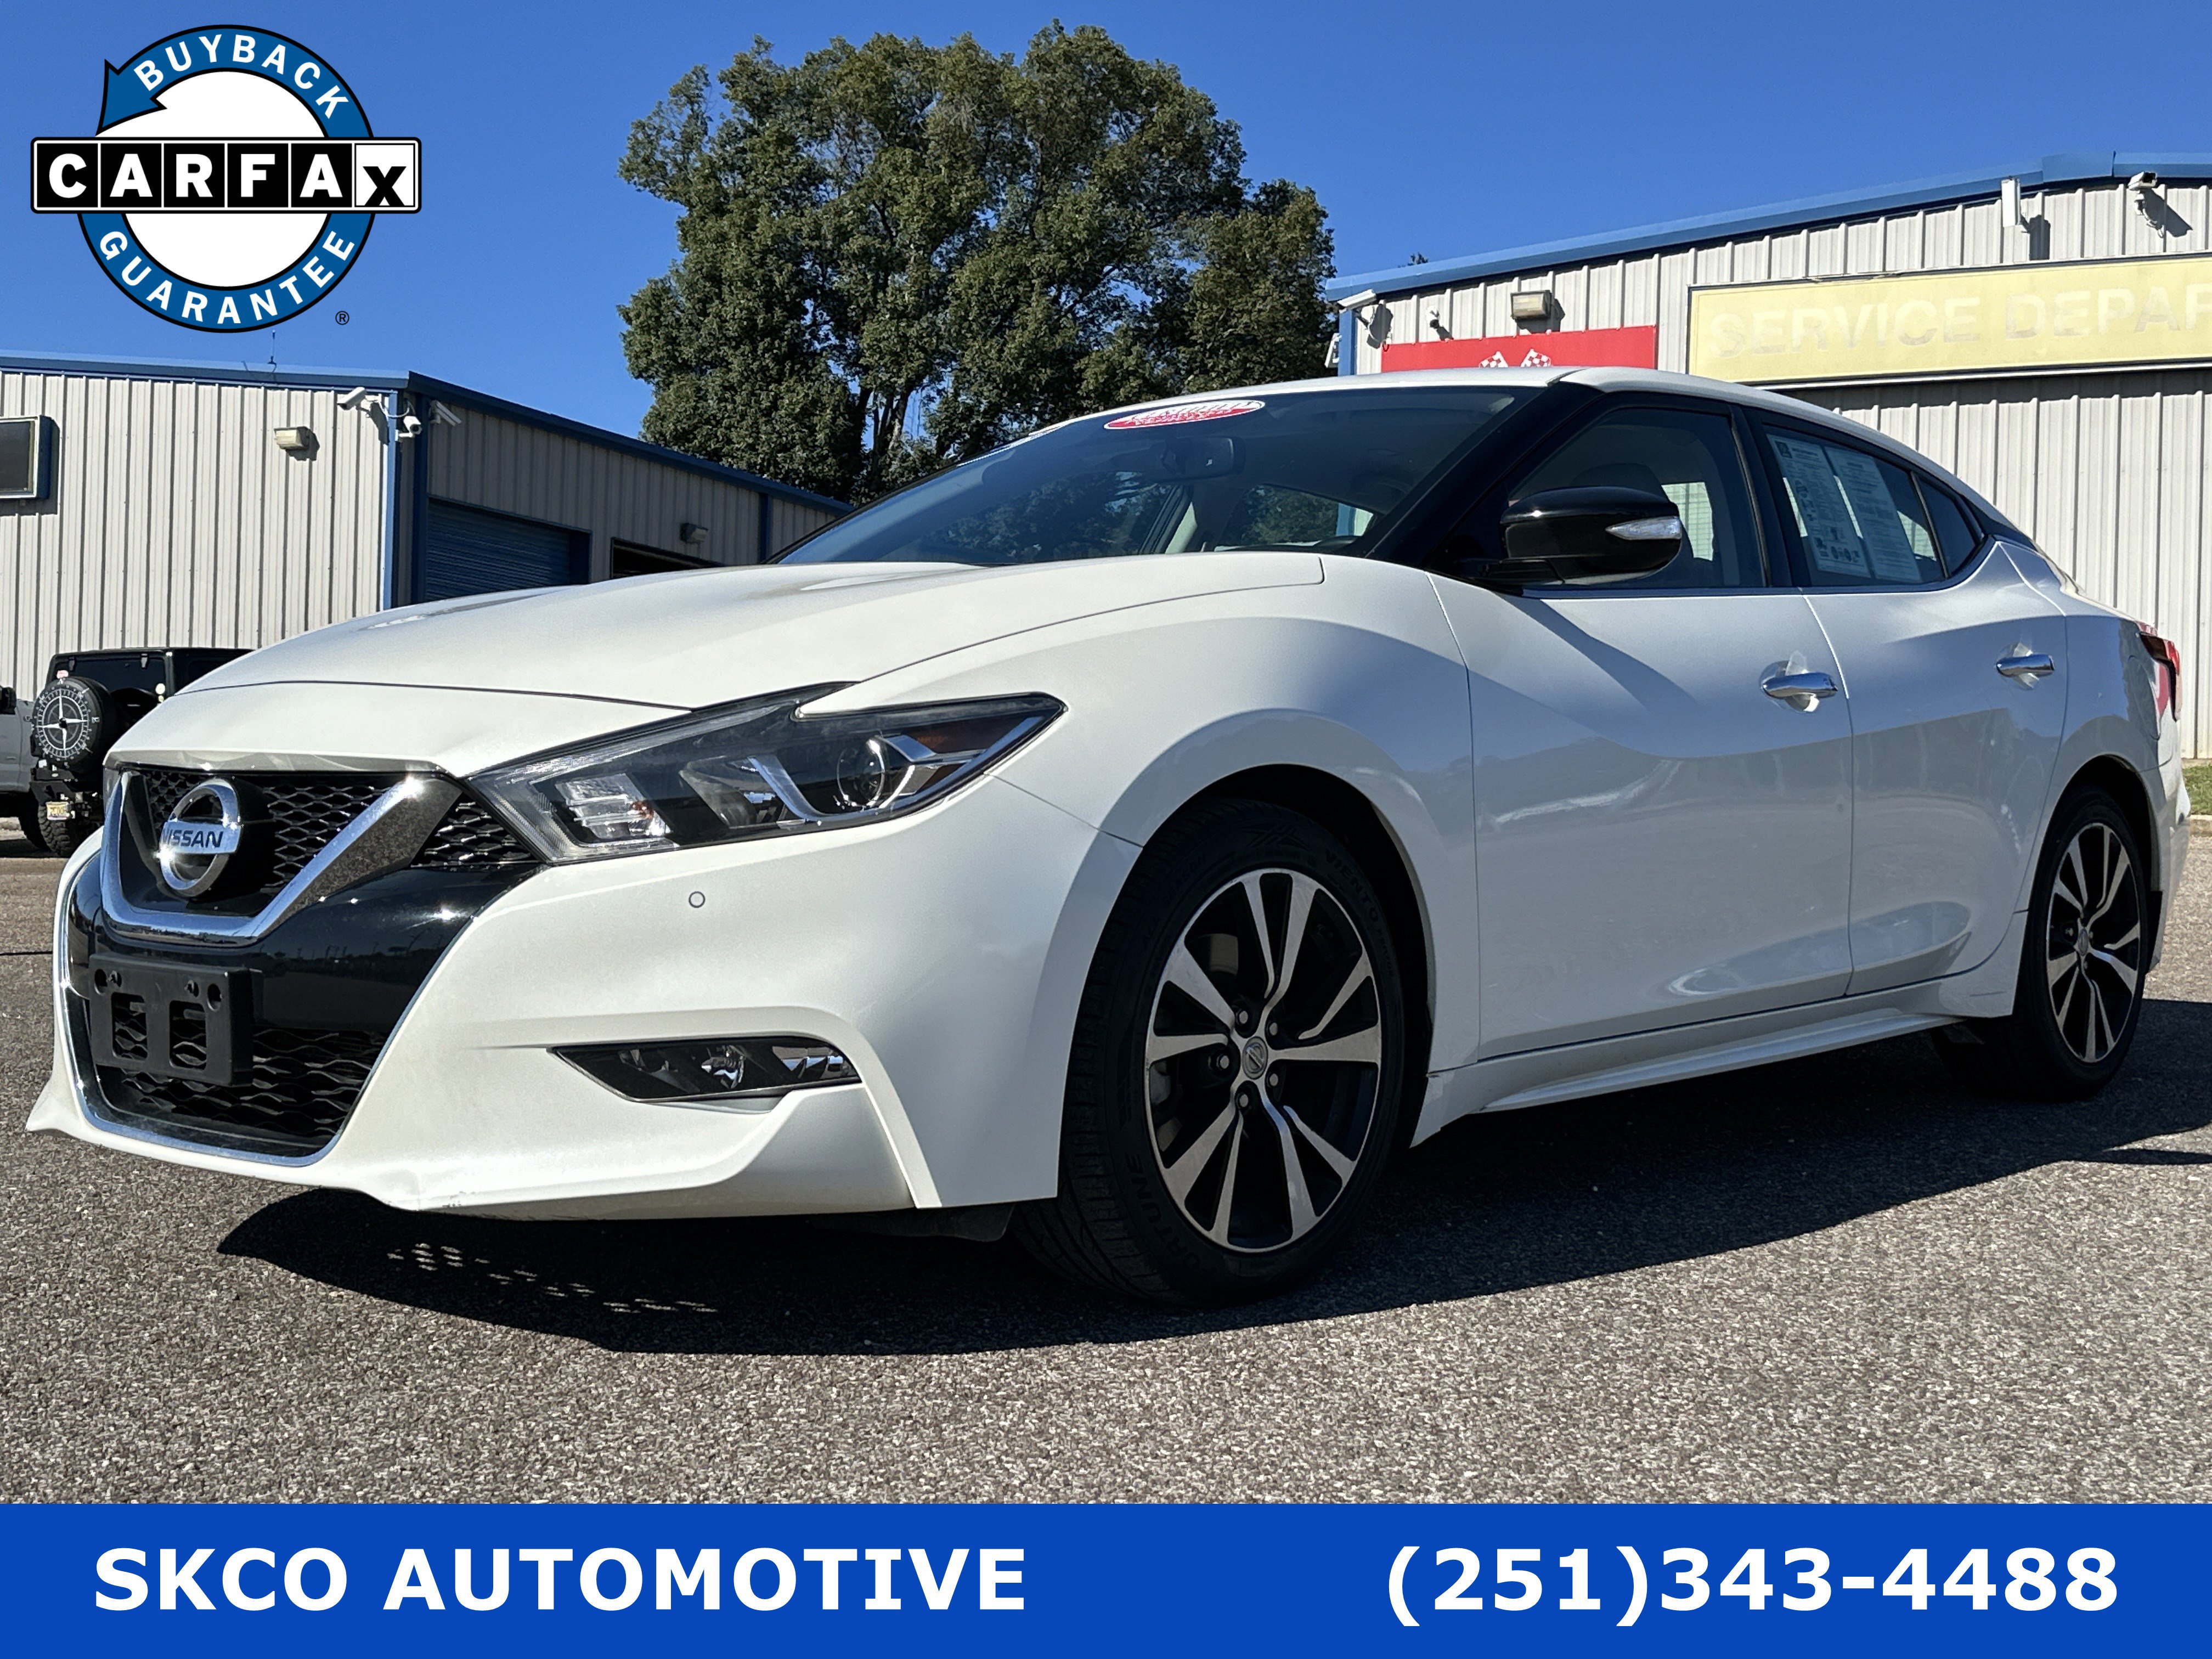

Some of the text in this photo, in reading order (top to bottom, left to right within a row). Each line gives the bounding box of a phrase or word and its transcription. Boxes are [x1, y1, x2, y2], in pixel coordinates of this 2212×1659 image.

[1709, 297, 1980, 358] SERVICE
[161, 828, 223, 848] NISSAN
[1324, 848, 1379, 923] VIENTO
